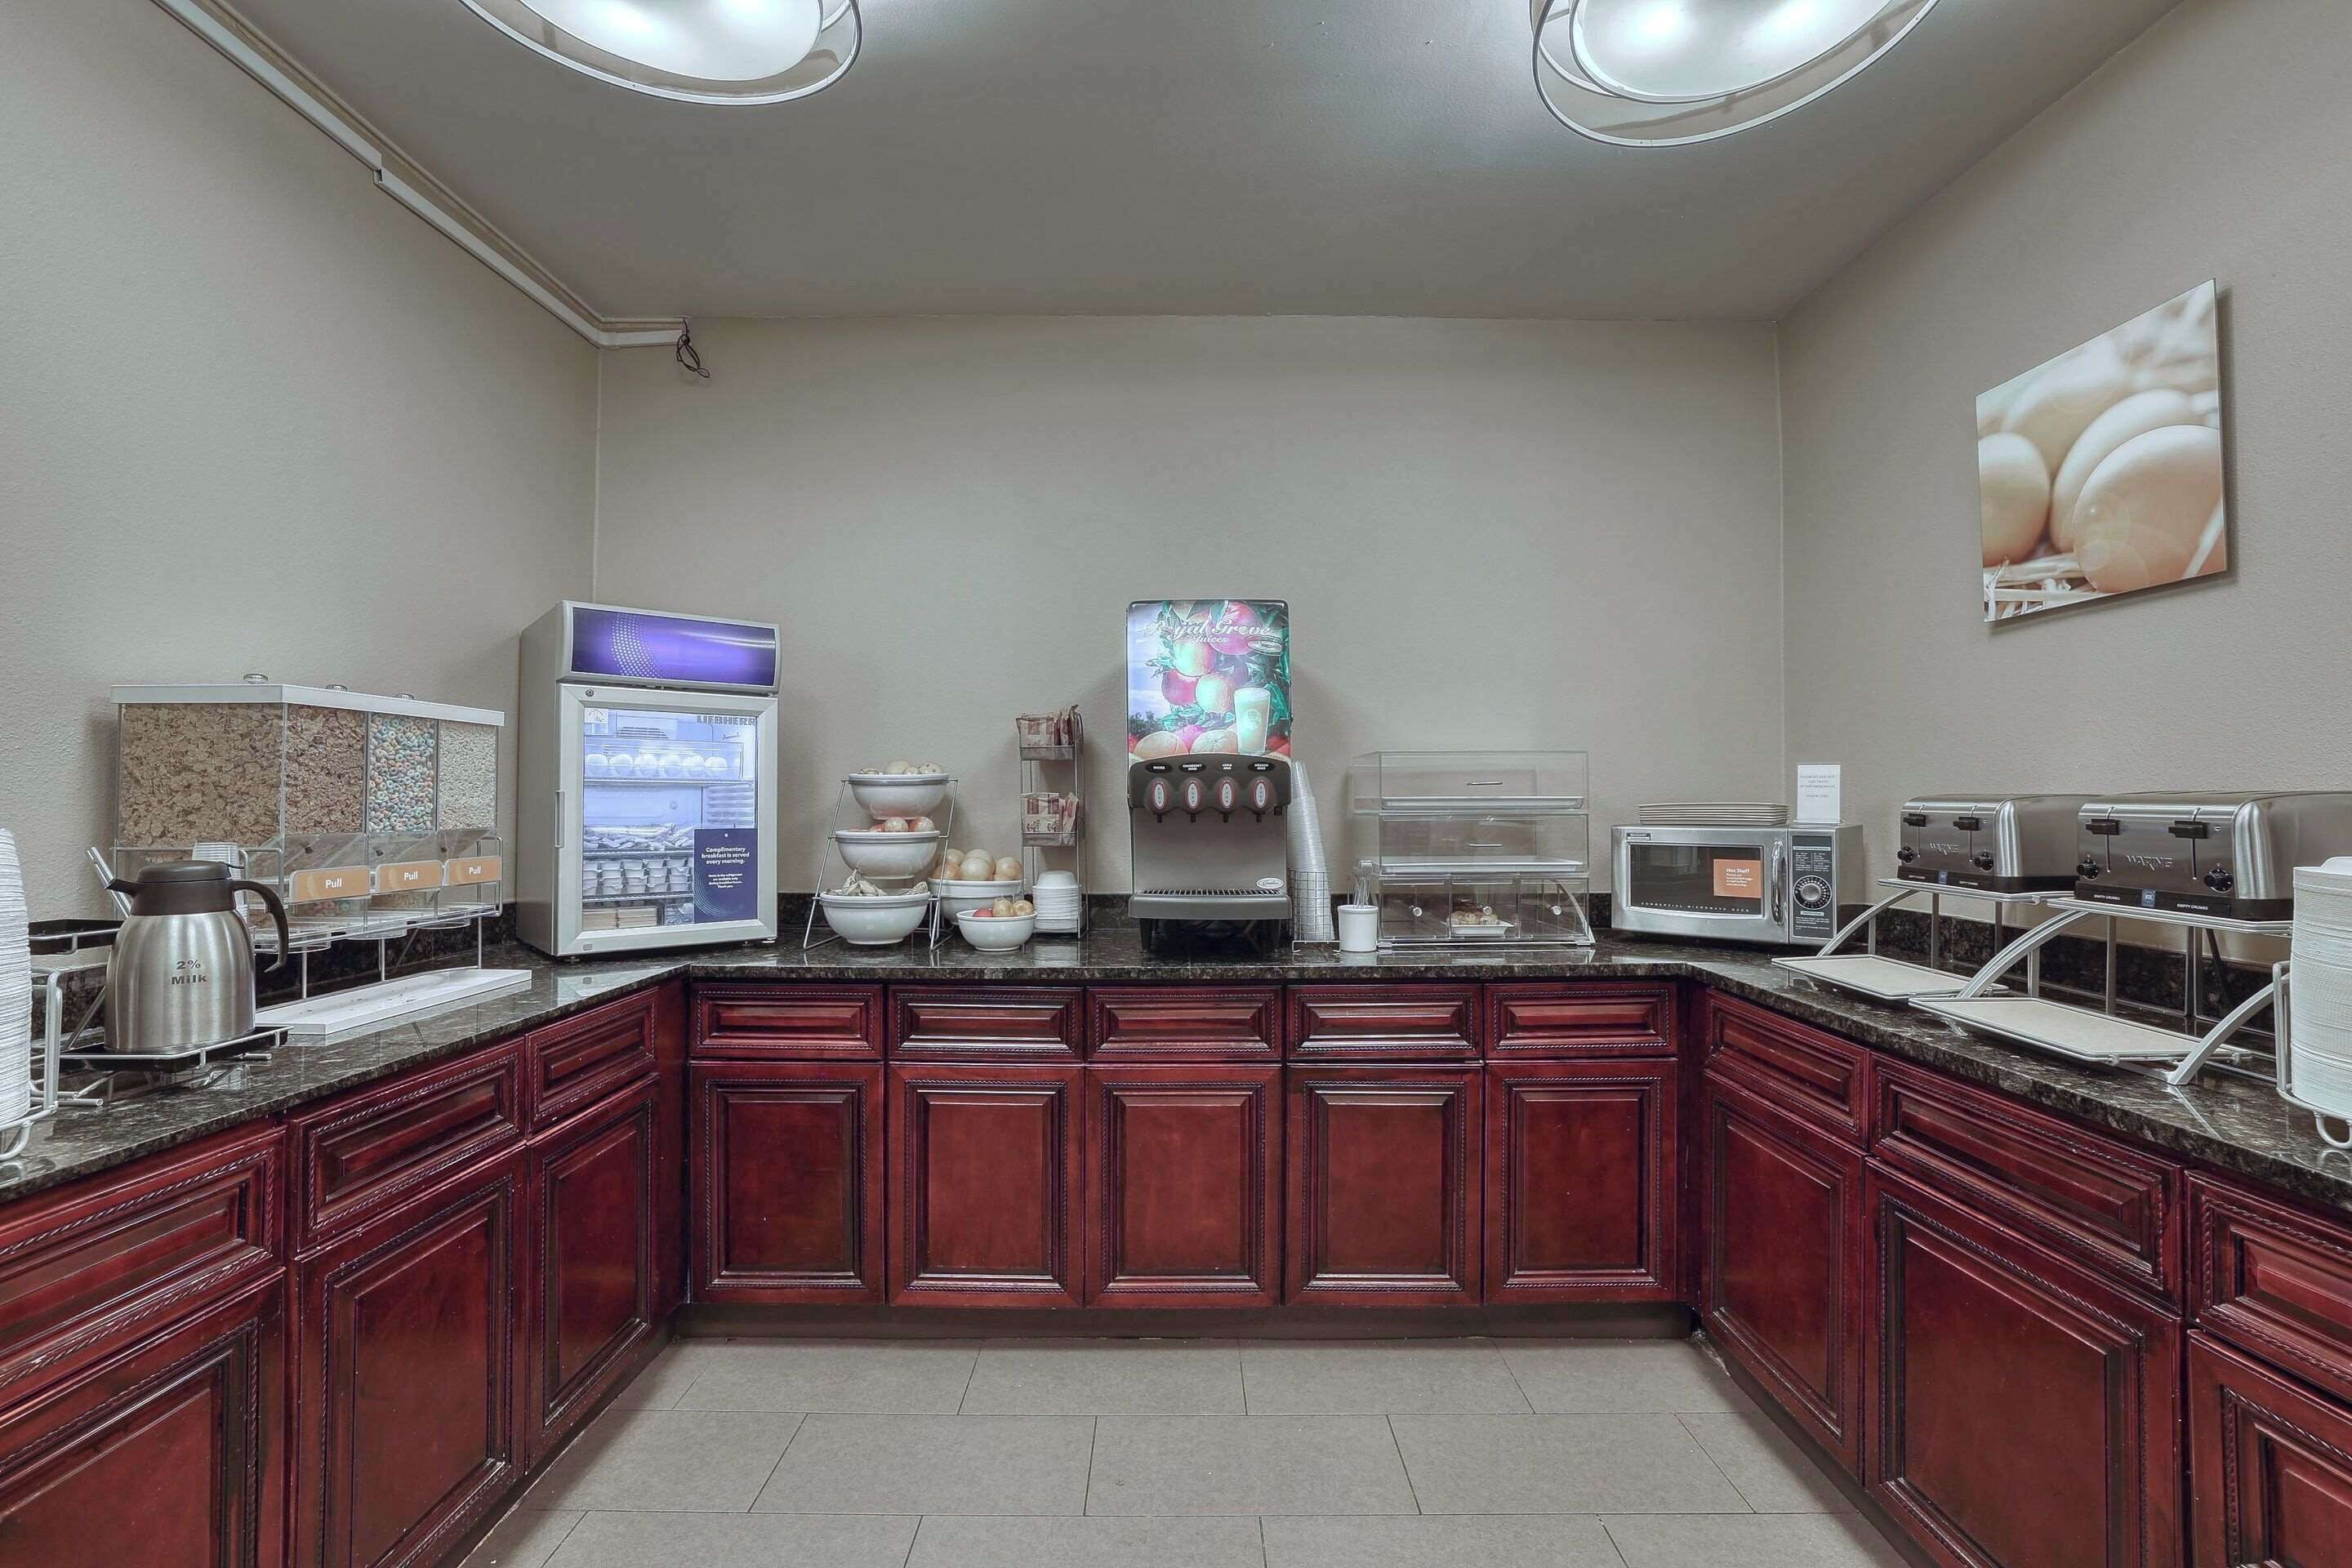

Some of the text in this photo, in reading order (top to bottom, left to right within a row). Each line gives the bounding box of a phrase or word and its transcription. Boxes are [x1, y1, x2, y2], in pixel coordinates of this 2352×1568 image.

[1212, 619, 1271, 635] Grove
[1192, 634, 1229, 644] Juices
[697, 715, 755, 726] LIEBHERR
[469, 866, 482, 875] Pull
[403, 871, 418, 881] Pull
[325, 879, 342, 889] Pull
[176, 960, 201, 970] 2%
[172, 974, 207, 985] Milk
